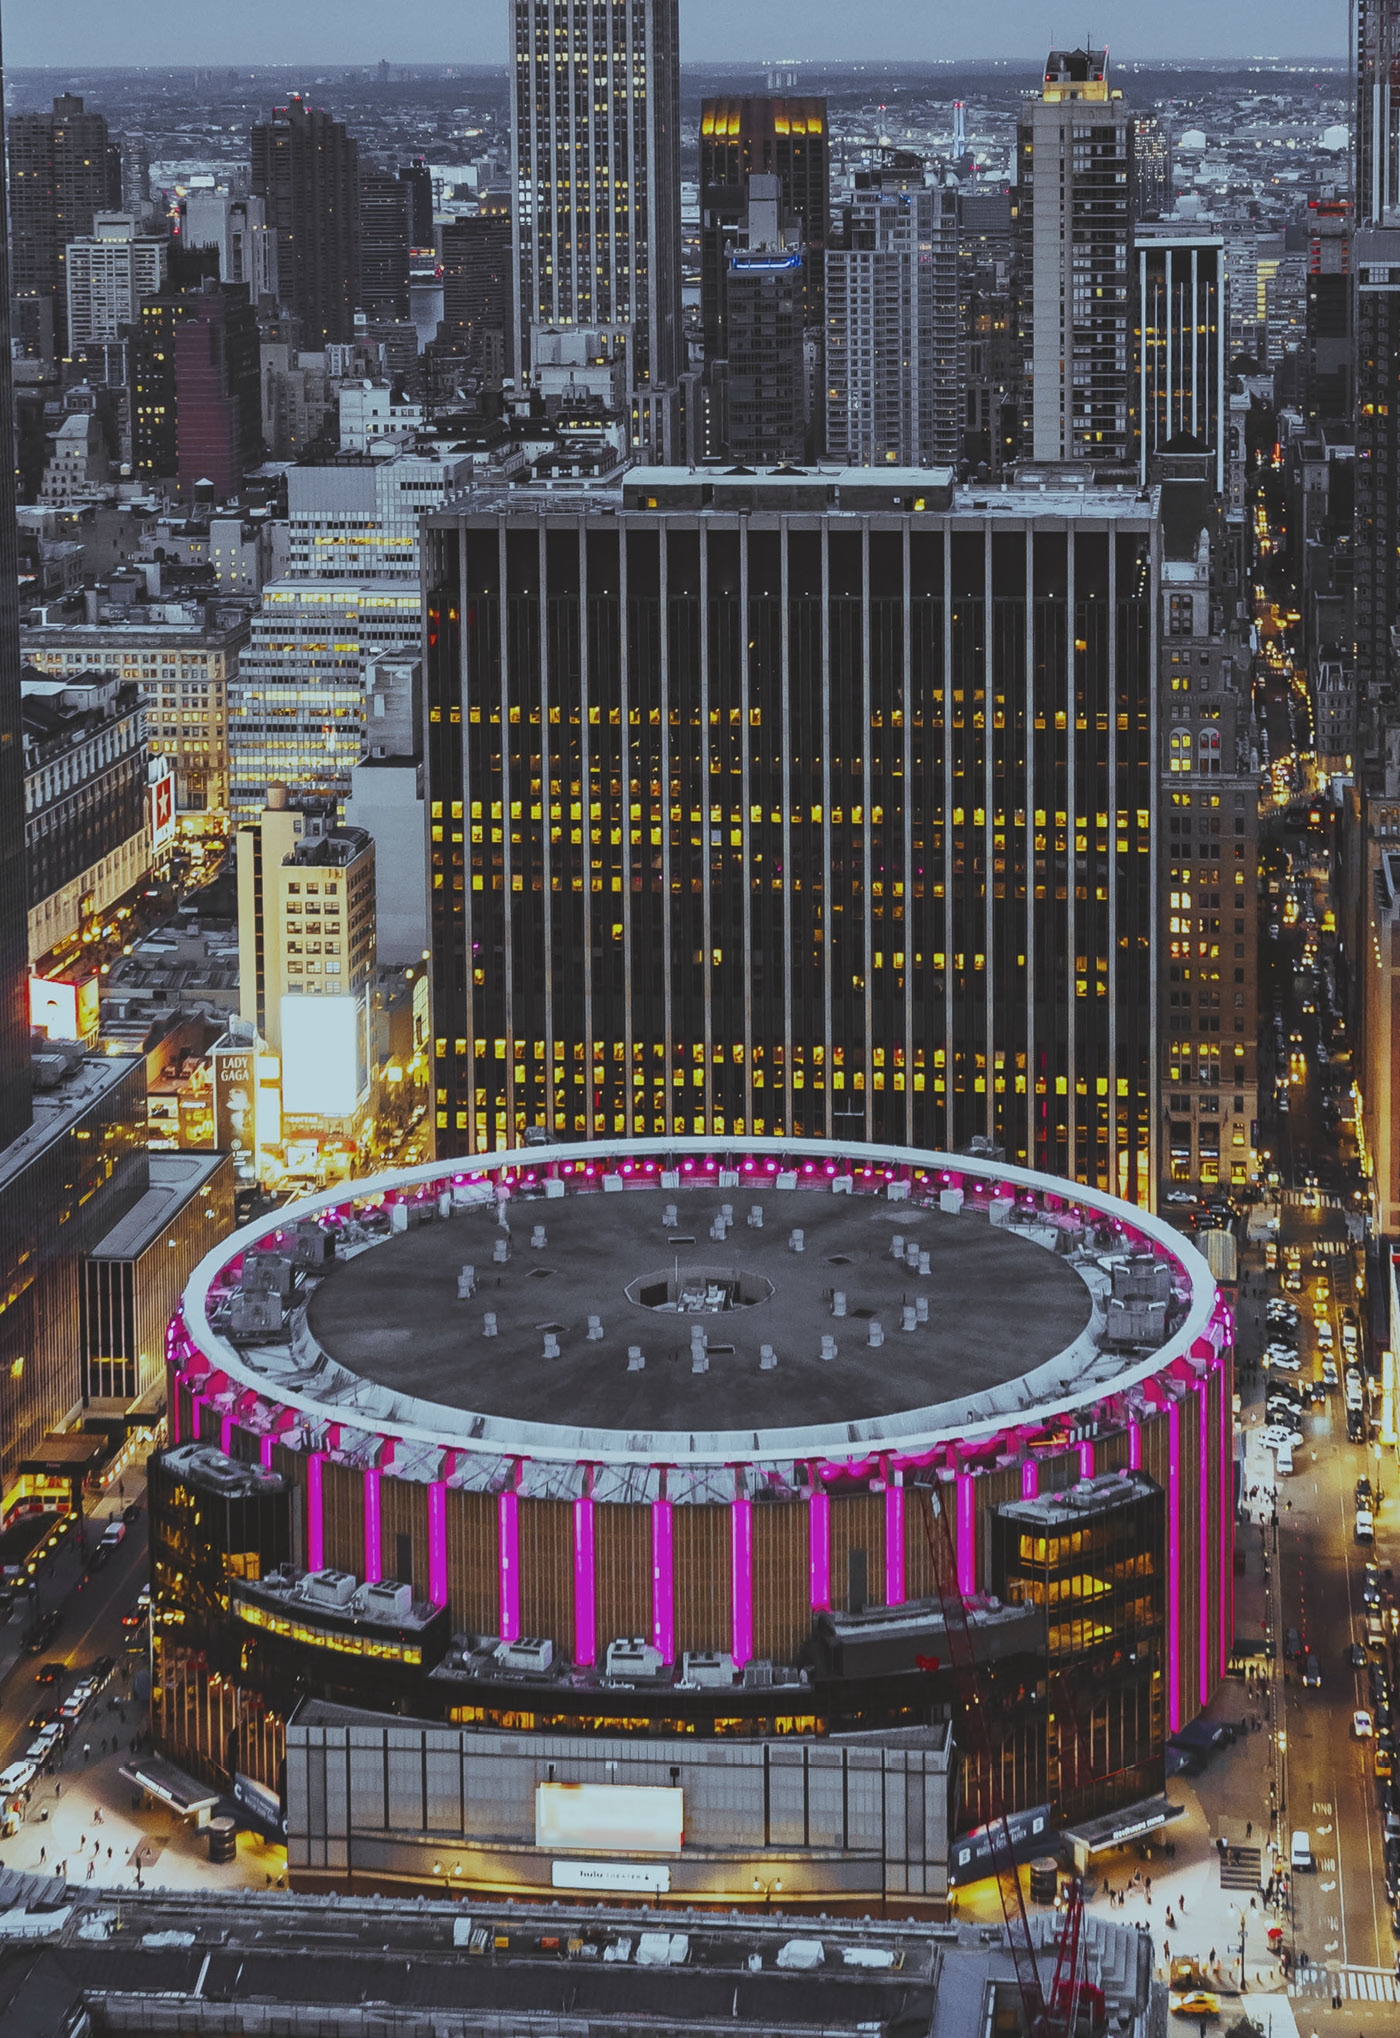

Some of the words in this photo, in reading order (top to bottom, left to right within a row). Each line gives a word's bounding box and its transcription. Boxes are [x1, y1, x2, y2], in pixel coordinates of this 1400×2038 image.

[222, 1057, 249, 1069] LADY
[221, 1069, 249, 1081] GAGA
[580, 1870, 603, 1878] hulu
[606, 1872, 641, 1880] THEATER
[1319, 1916, 1338, 1931] ON
